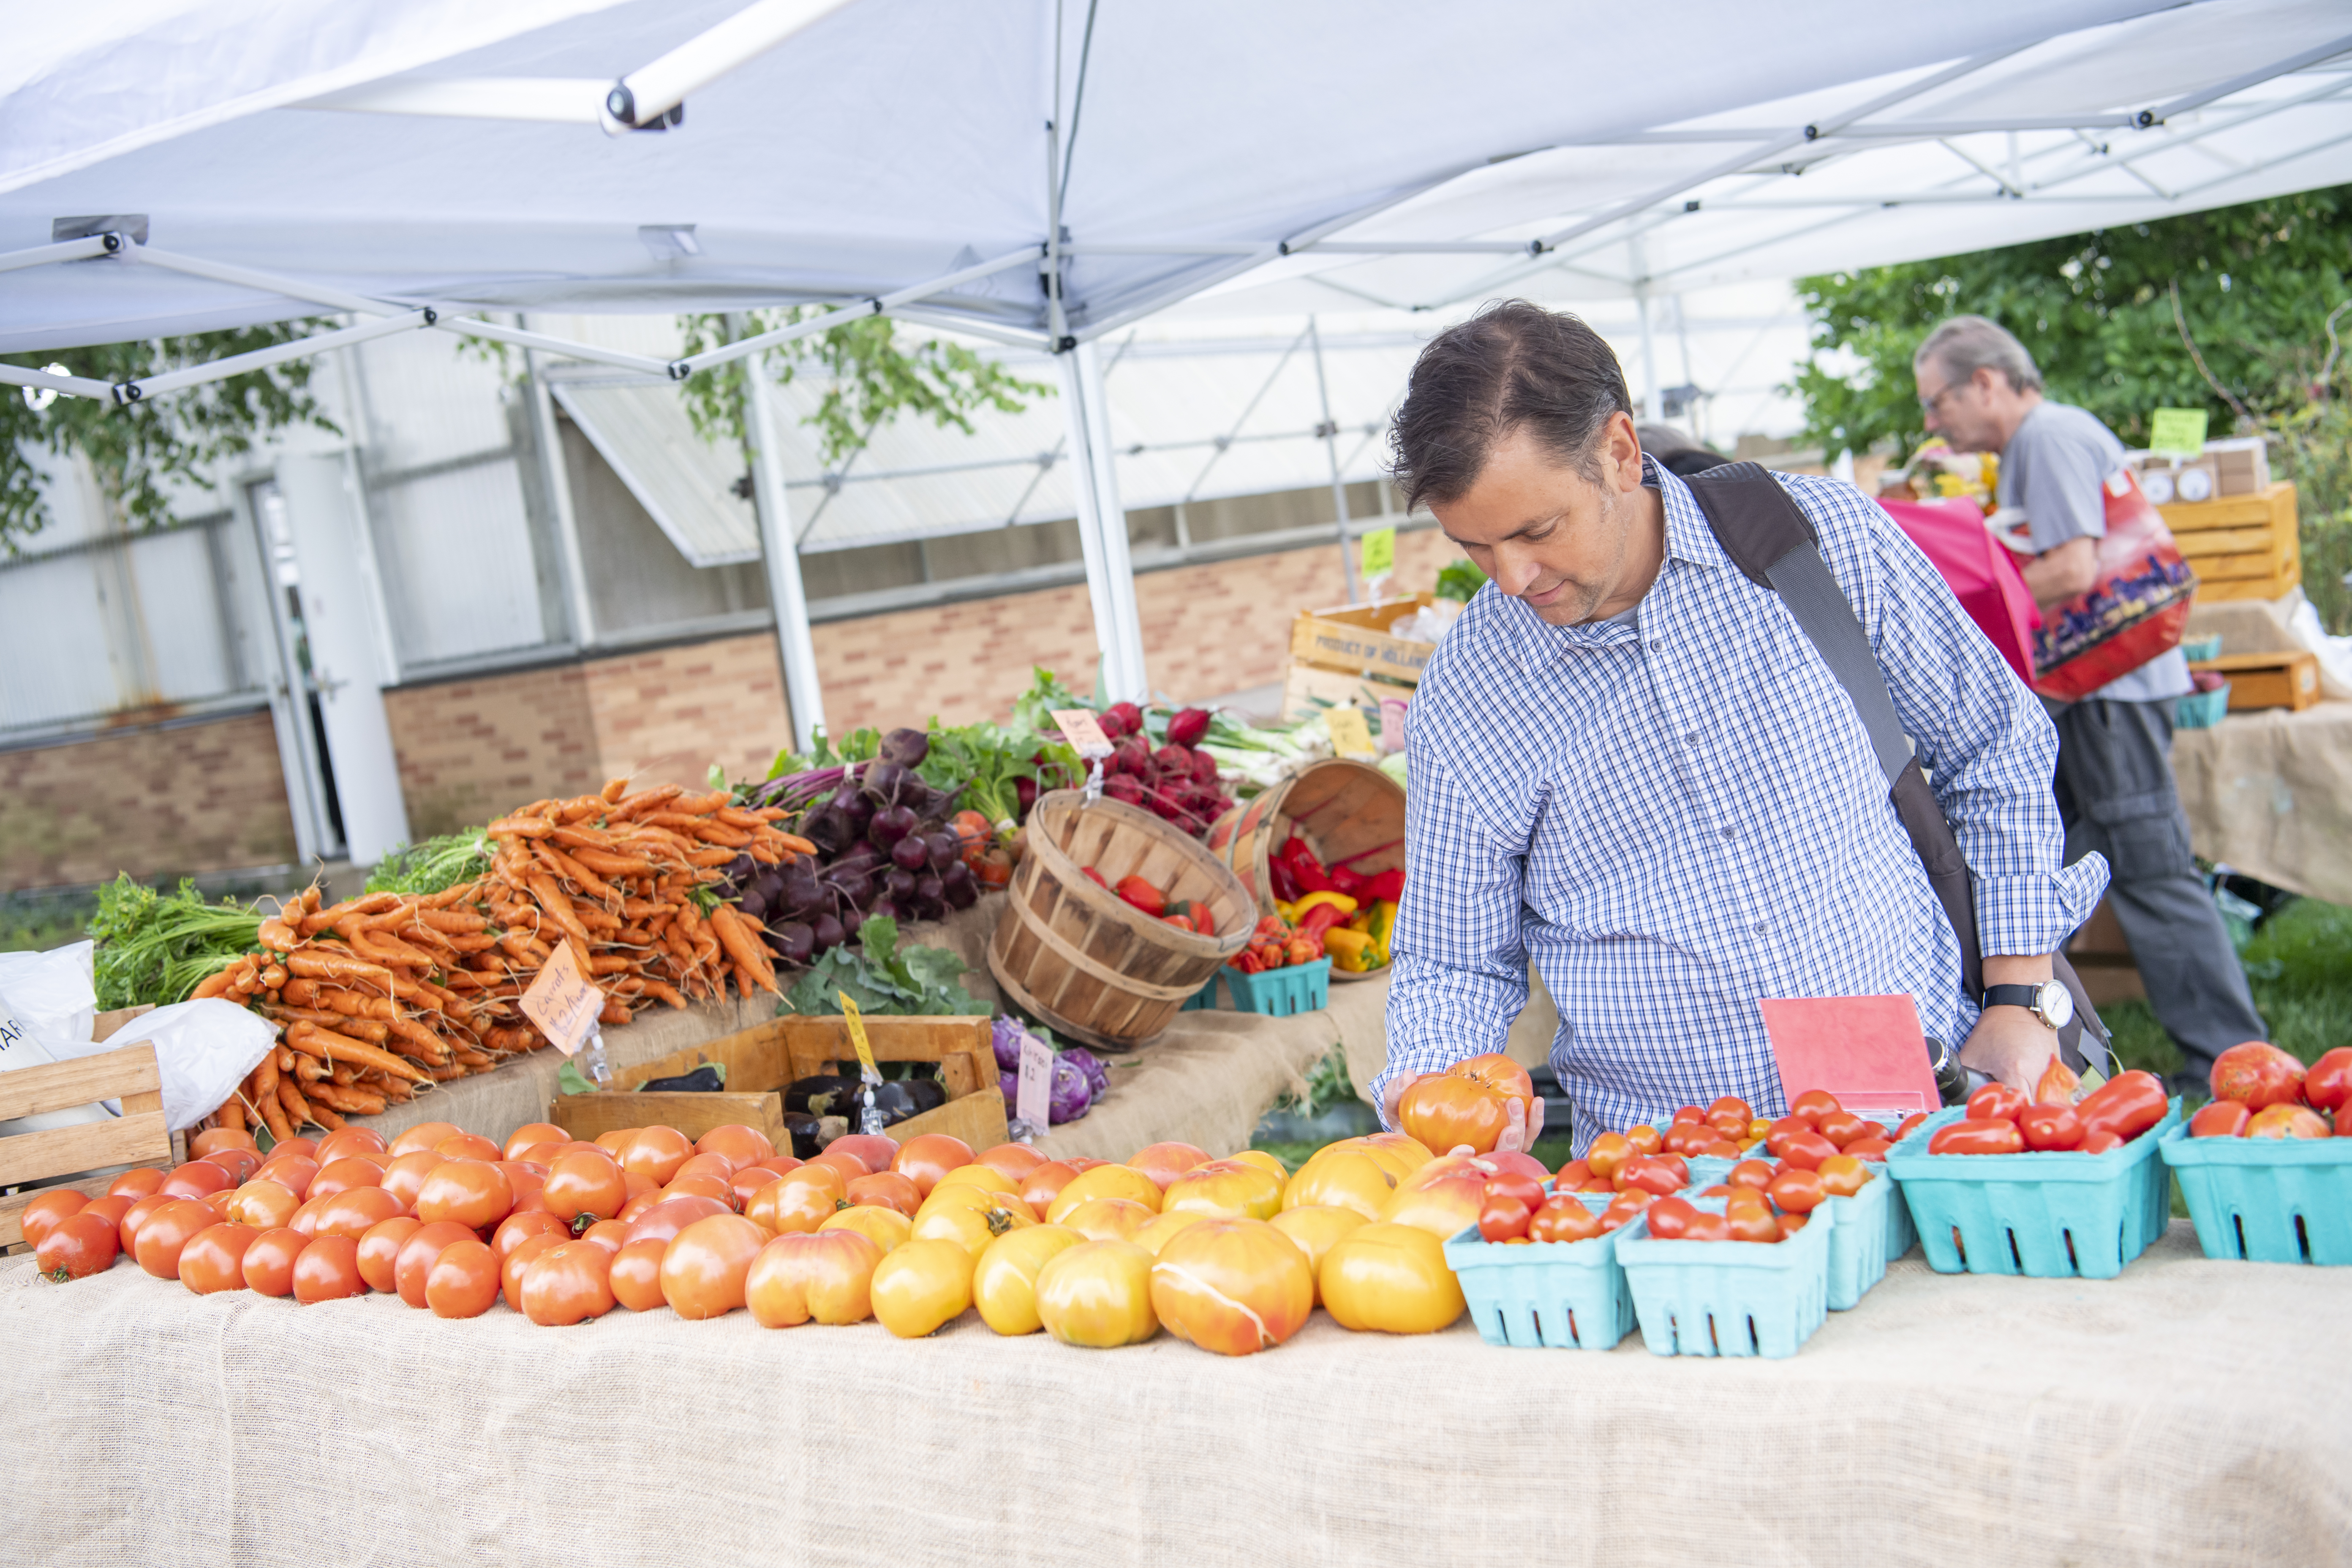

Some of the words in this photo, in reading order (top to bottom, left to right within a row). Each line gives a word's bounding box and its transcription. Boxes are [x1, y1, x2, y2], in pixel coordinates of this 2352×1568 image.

[1316, 635, 1361, 655] PRODUCT
[1365, 644, 1377, 659] OF
[537, 964, 569, 1016] Carrots
[0, 1019, 25, 1051] AR
